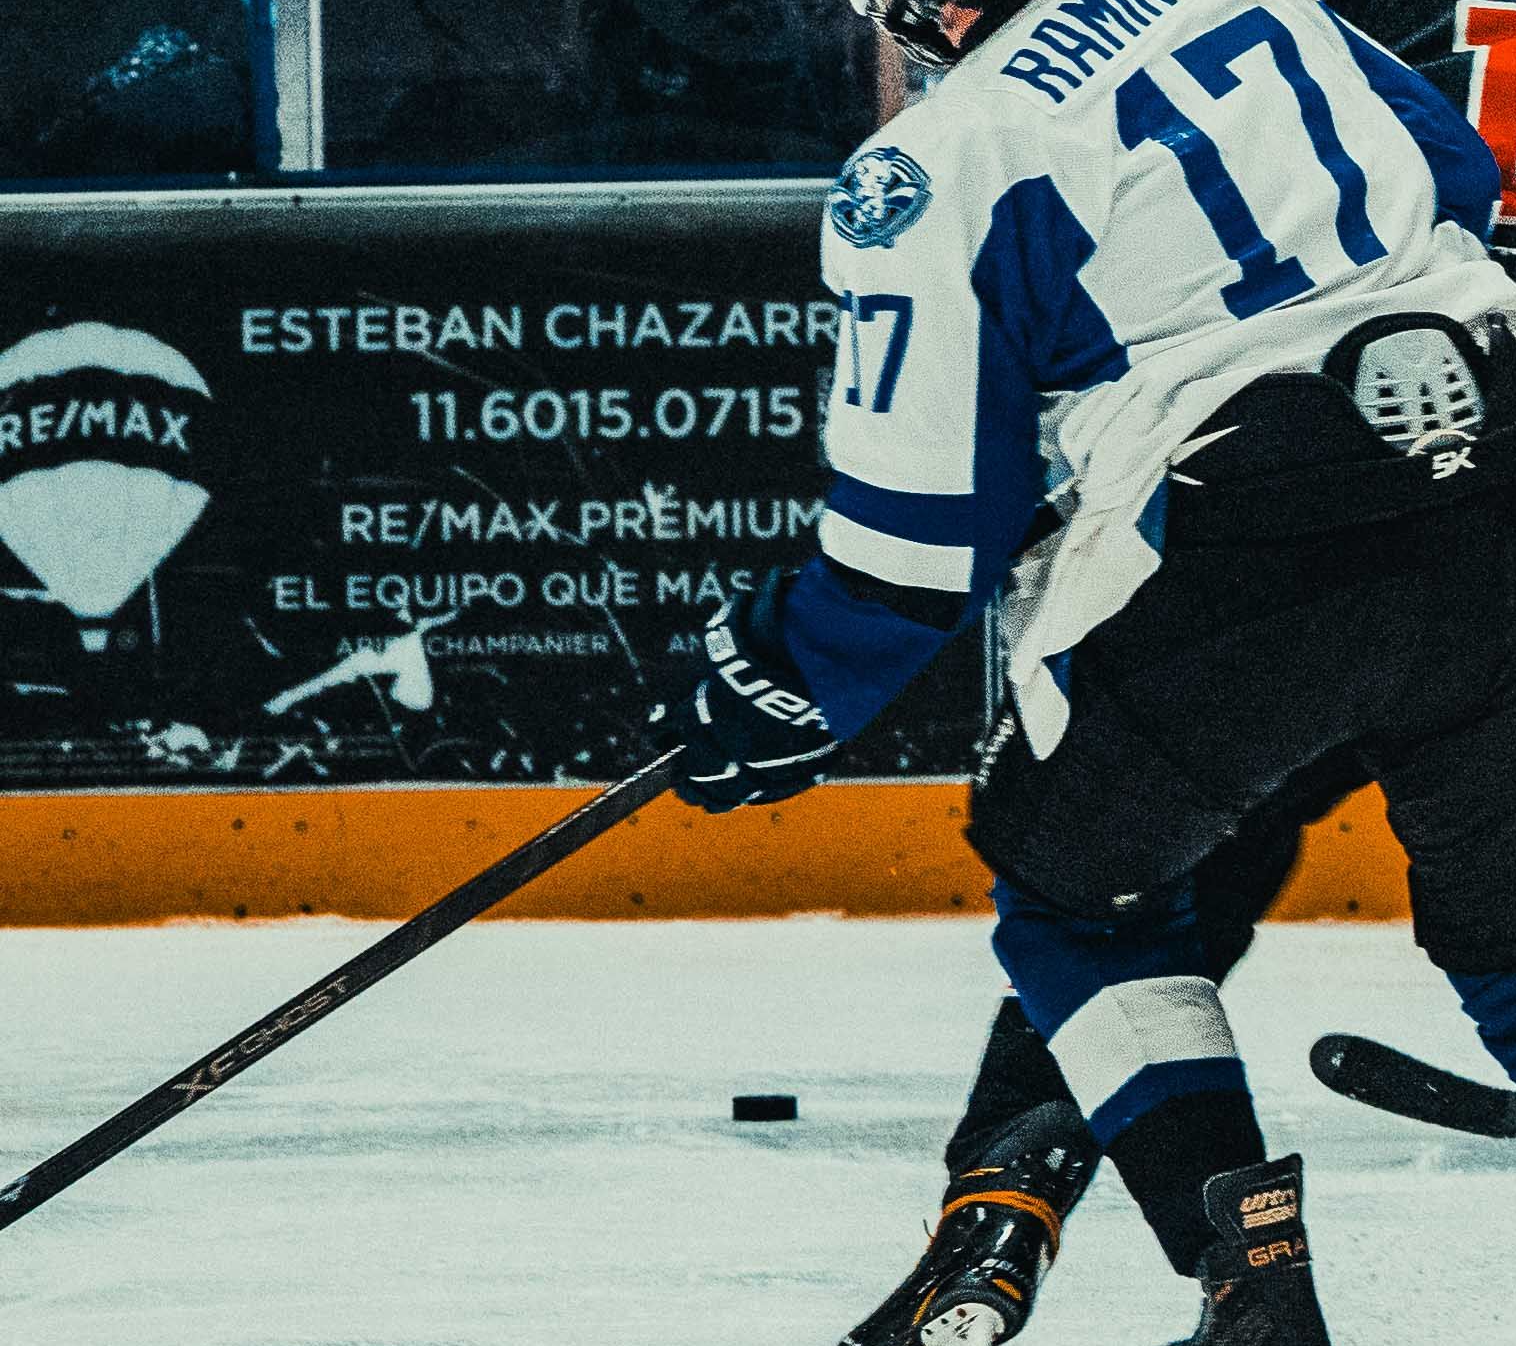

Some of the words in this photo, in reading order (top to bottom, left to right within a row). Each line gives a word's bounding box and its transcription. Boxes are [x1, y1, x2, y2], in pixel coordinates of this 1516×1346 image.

[1114, 5, 1391, 322] 17
[240, 304, 524, 353] ESTEBAN
[0, 398, 191, 454] RE/MAX
[409, 386, 804, 443] 11.6015.0715
[341, 499, 560, 550] RE/MAX
[273, 573, 331, 610] EL
[345, 570, 528, 611] EQUIPO
[541, 568, 641, 606] QUE
